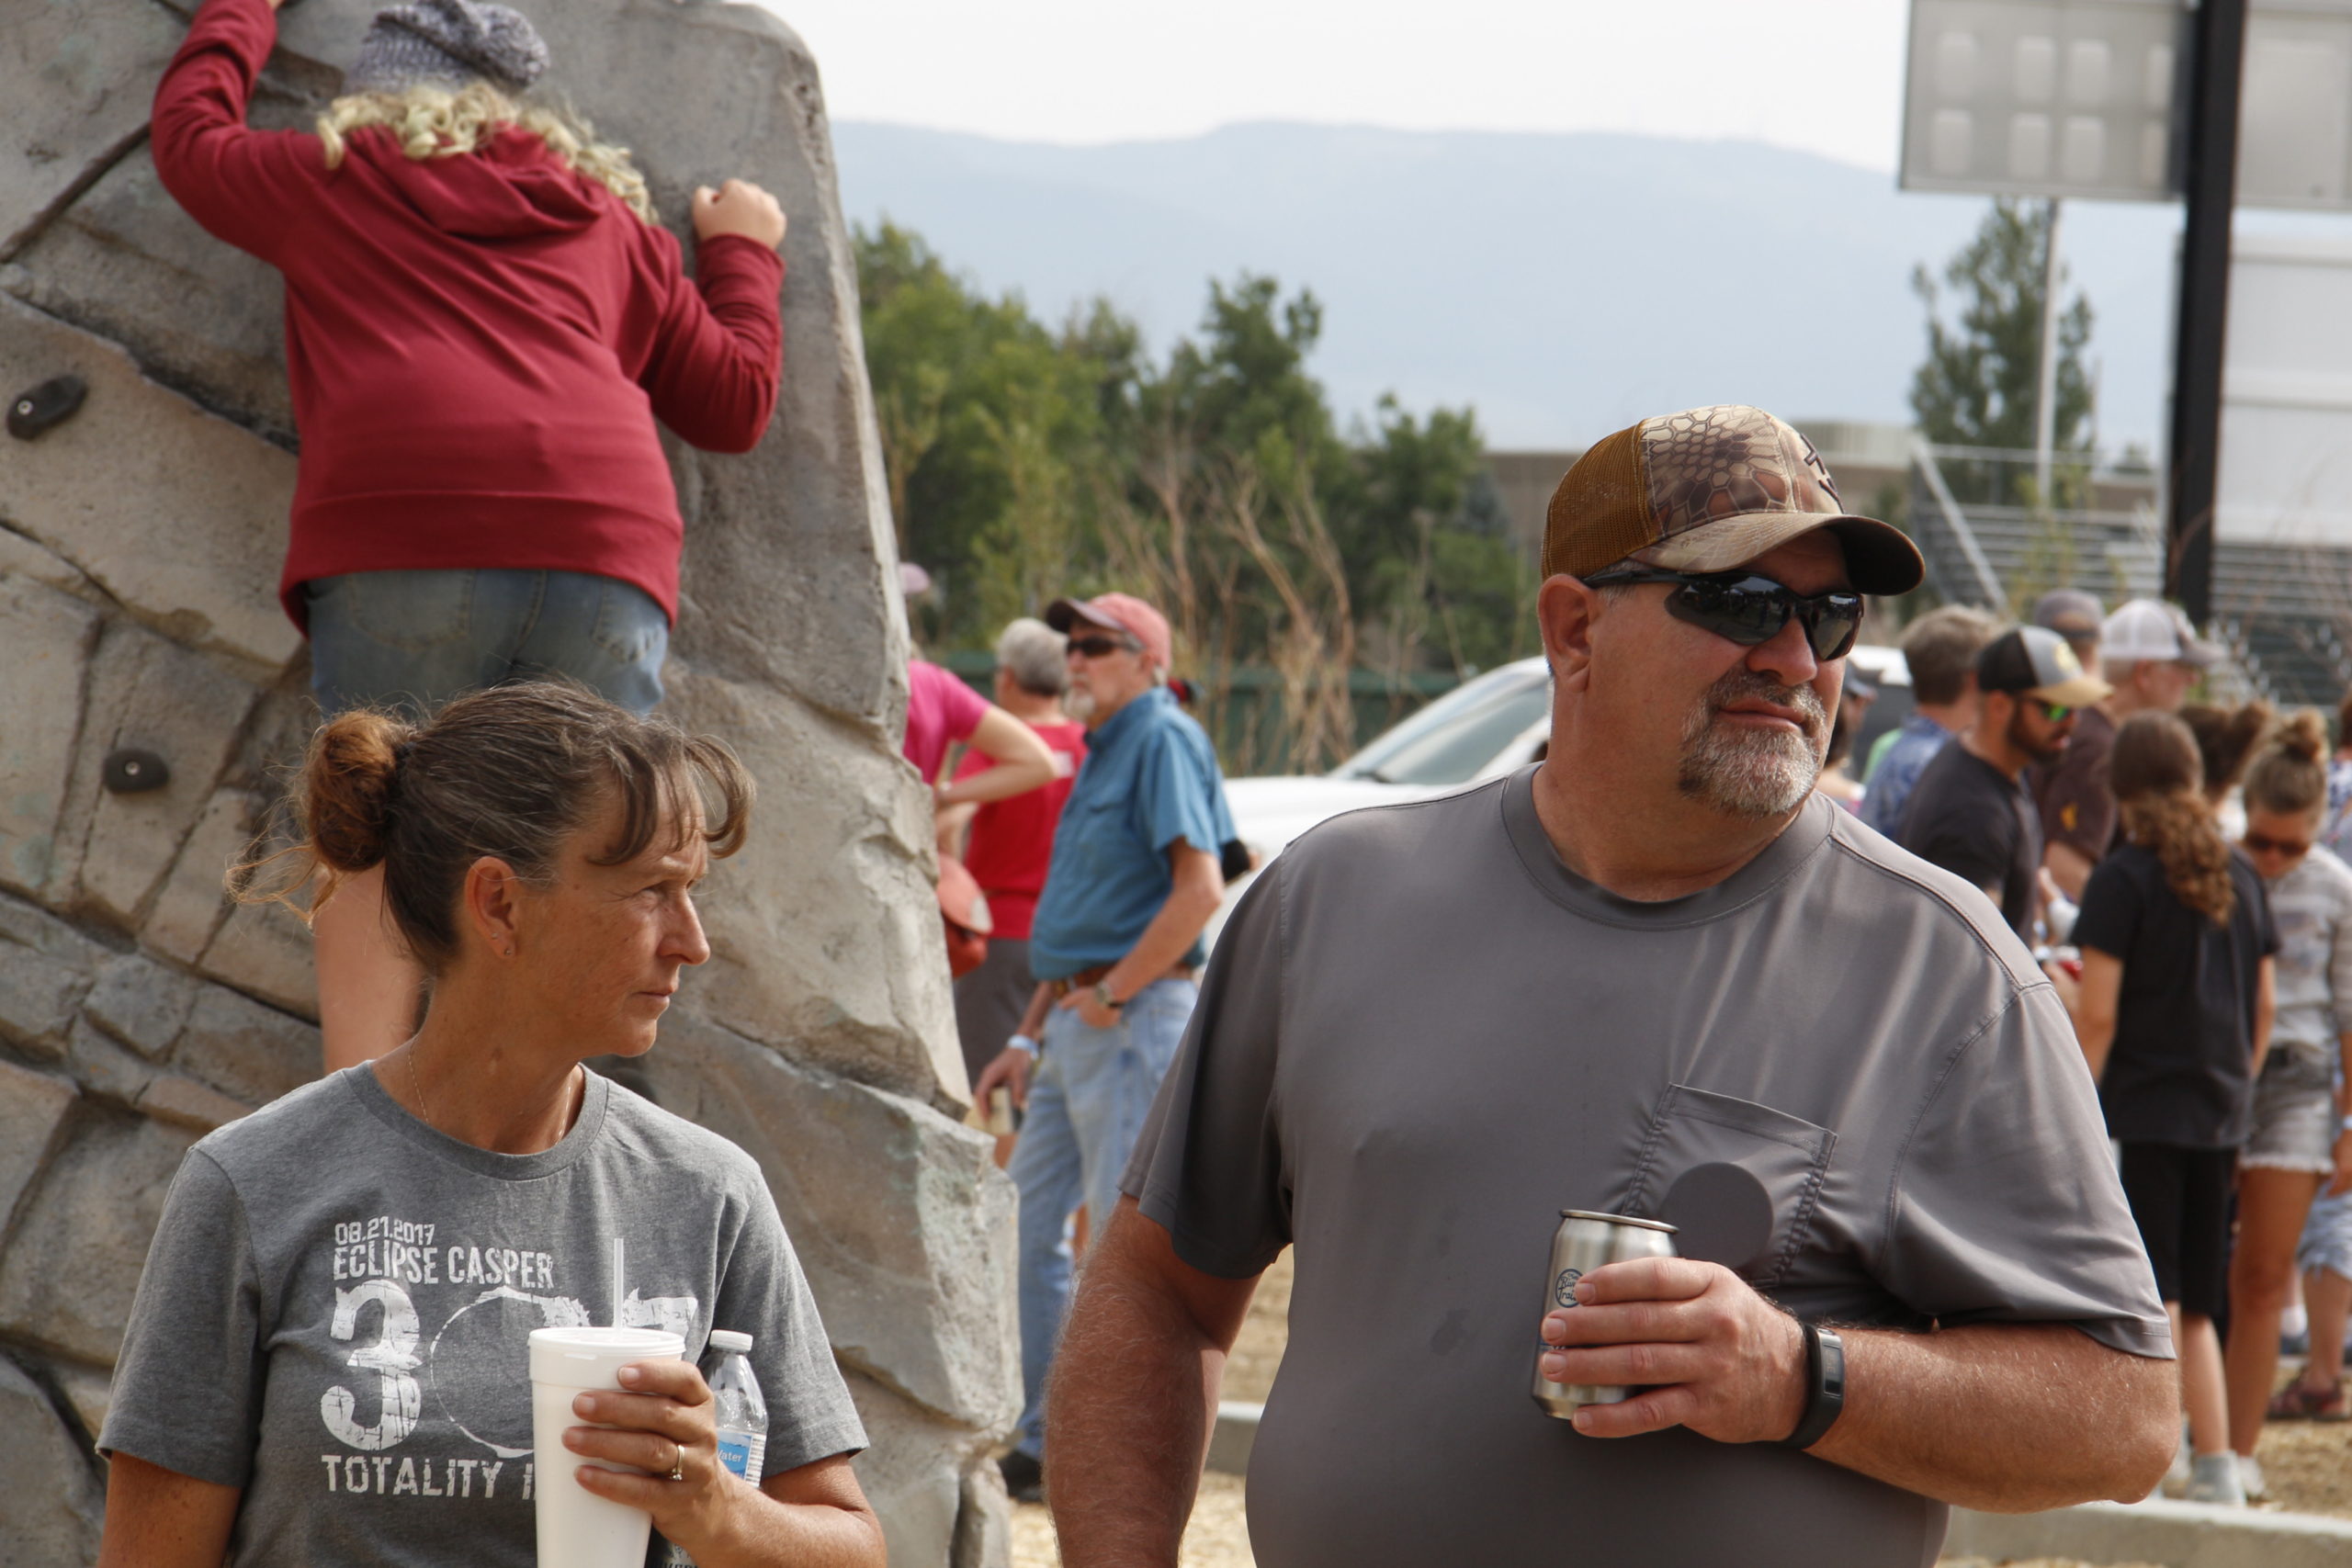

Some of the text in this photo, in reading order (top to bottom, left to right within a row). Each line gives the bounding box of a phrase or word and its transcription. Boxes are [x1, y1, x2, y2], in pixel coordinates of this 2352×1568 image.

[334, 1215, 436, 1247] 08.21.2017
[333, 1239, 555, 1289] ECLIPSE CASPER
[1558, 1287, 1577, 1302] Trai
[321, 1454, 504, 1499] TOTALITY
